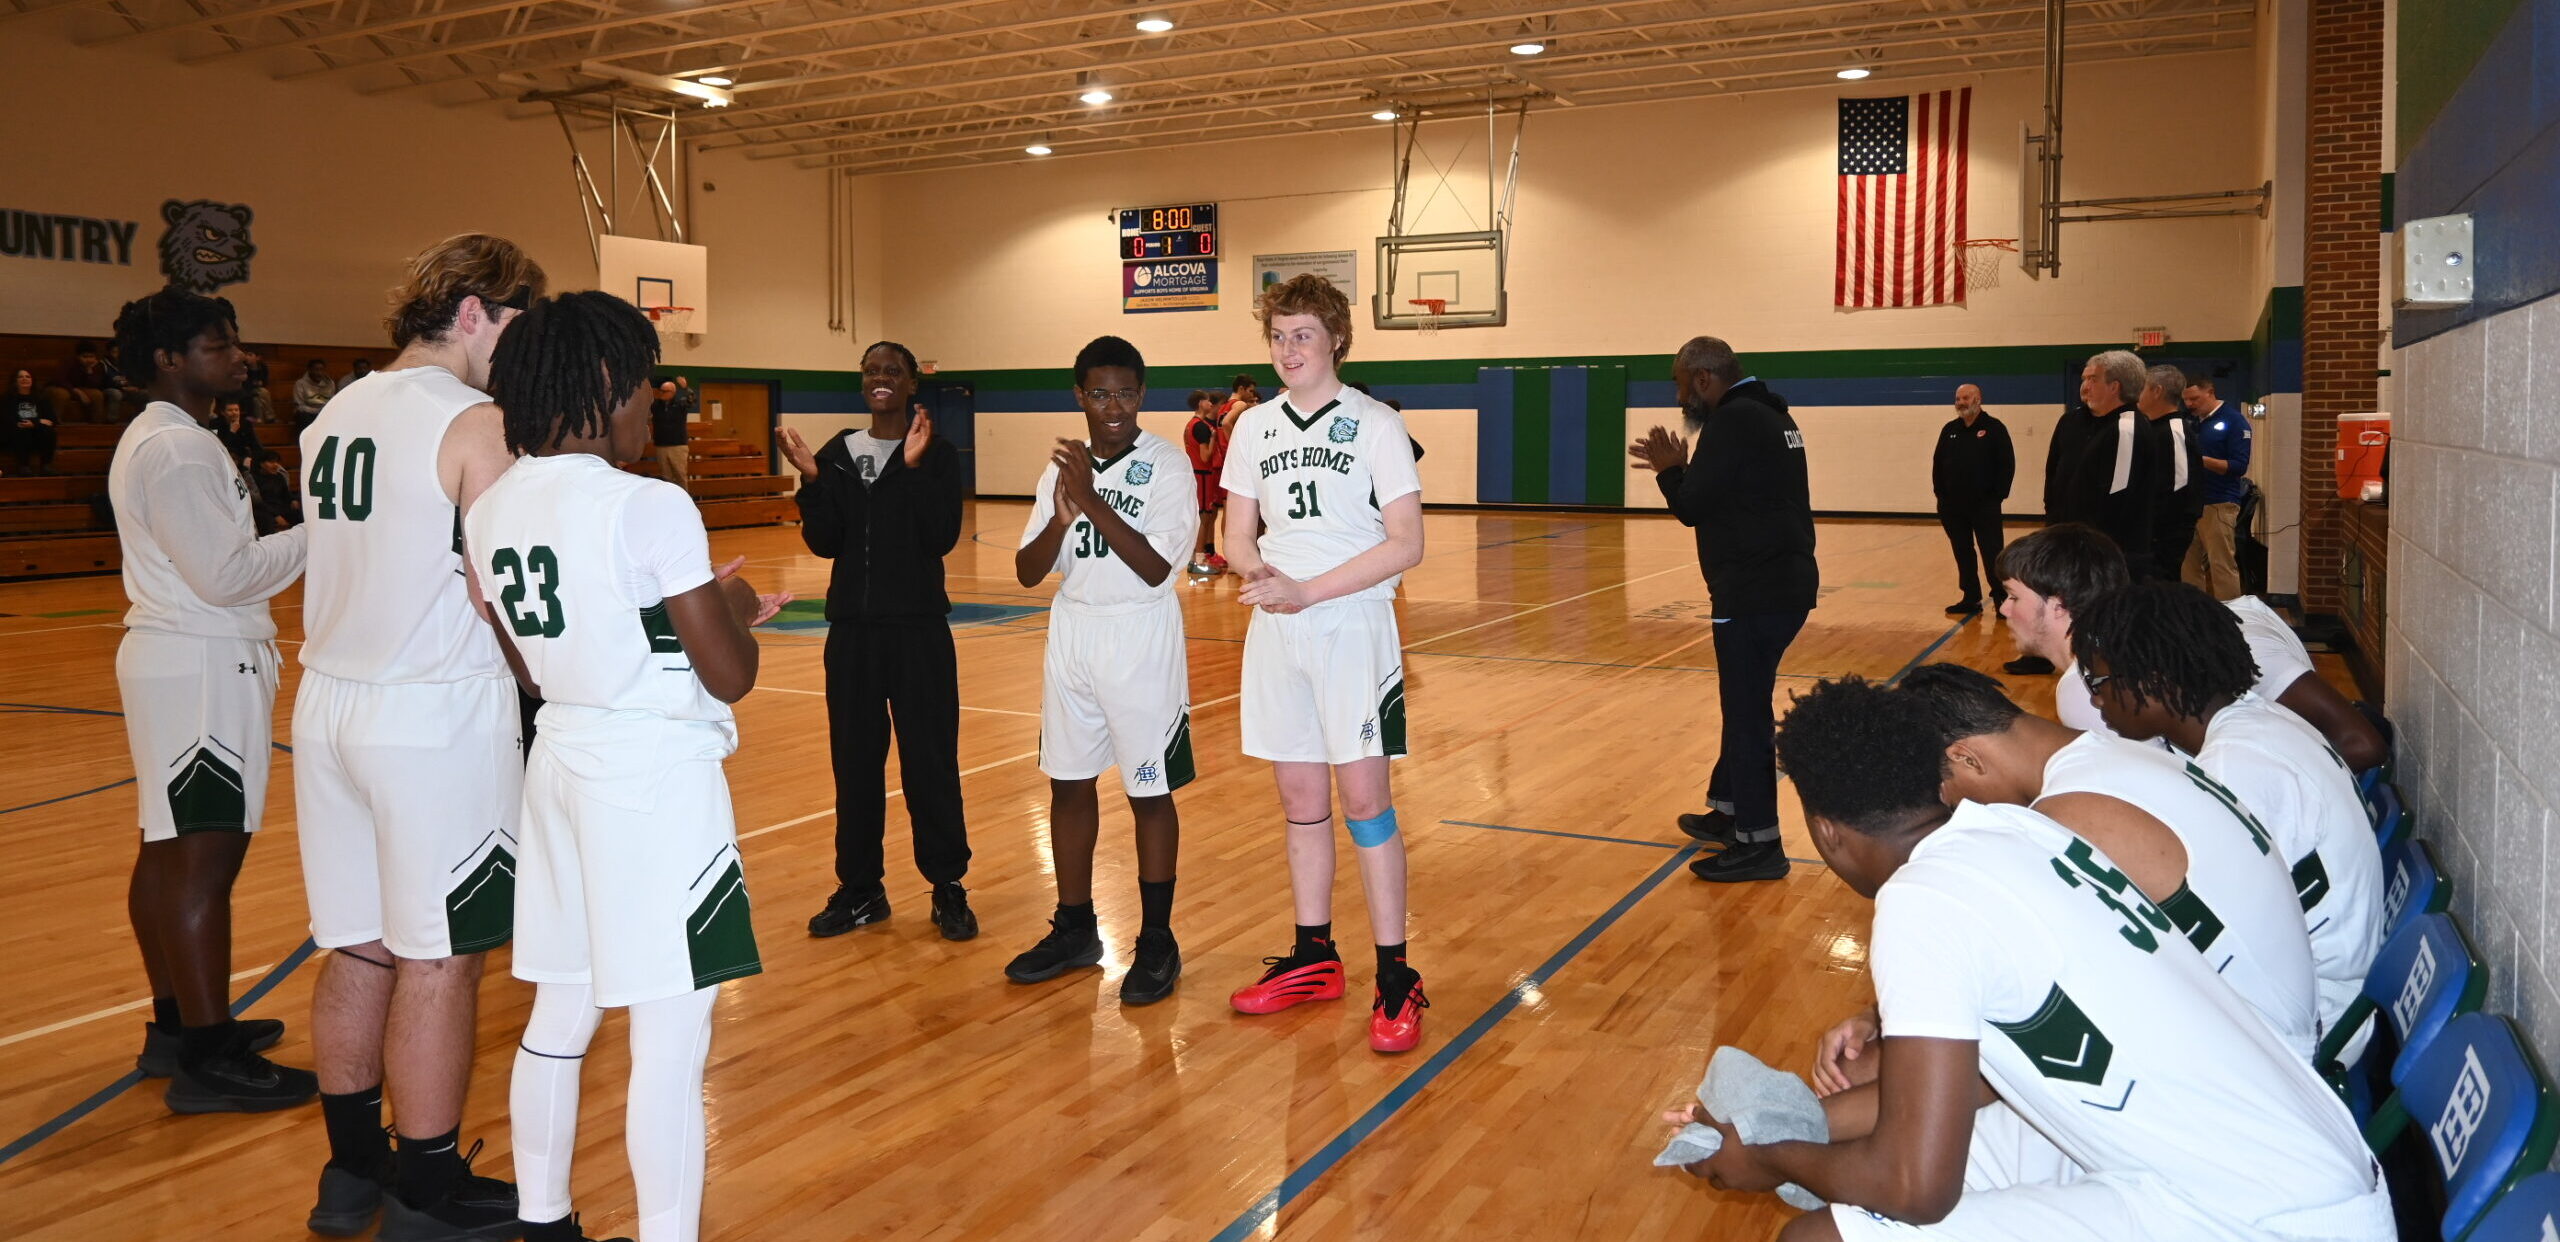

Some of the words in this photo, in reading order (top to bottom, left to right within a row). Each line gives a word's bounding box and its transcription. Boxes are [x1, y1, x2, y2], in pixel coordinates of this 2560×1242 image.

[1153, 208, 1190, 231] 8:00
[1133, 237, 1144, 258] 0
[1200, 233, 1211, 254] 0
[1152, 276, 1207, 287] MORTGAGE
[1153, 263, 1207, 277] ALCOVA
[309, 435, 377, 522] 40
[1260, 449, 1298, 480] BOYS
[1301, 447, 1355, 475] HOME
[1288, 480, 1322, 520] 31
[1075, 521, 1109, 559] 30
[491, 545, 566, 639] 23
[2049, 835, 2173, 955] 35
